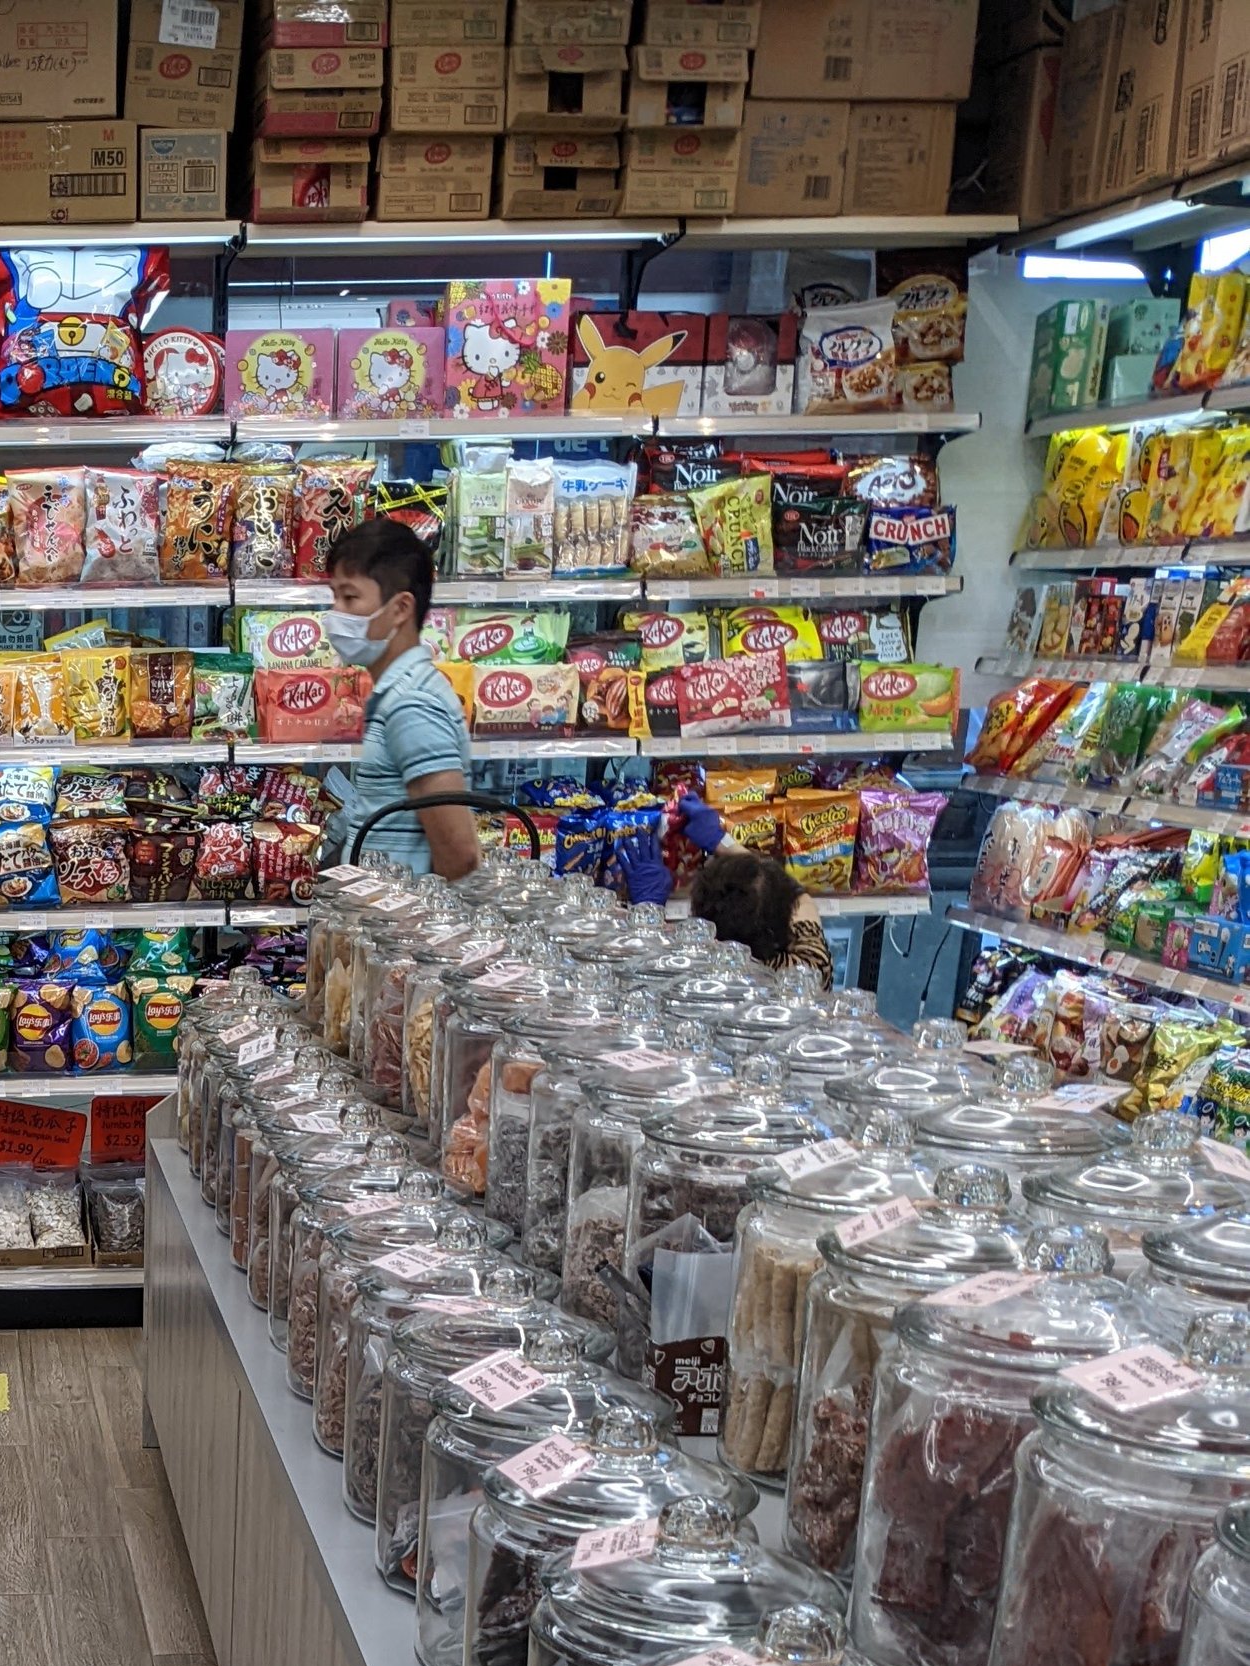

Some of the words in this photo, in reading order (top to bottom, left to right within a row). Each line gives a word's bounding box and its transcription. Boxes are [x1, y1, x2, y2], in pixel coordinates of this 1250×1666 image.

[93, 151, 124, 167] M50
[676, 462, 721, 484] Noir
[561, 478, 628, 494] 牛乳ケーキ
[114, 486, 138, 553] ふわっと
[872, 518, 950, 543] CRUNCH
[799, 524, 843, 546] Noir
[273, 624, 317, 652] KitKat
[464, 627, 507, 655] KitKat
[748, 623, 794, 649] KitKat
[267, 659, 293, 669] BANANA
[294, 658, 323, 669] CARAMEL
[282, 681, 324, 708] KitKat
[484, 678, 527, 700] KitKat
[688, 671, 729, 699] KitKat
[864, 674, 914, 697] KitKat
[732, 816, 776, 844] Cheetos
[801, 806, 848, 836] Cheetos
[0, 1127, 22, 1138] Salted
[22, 1130, 53, 1143] Pumpkin
[53, 1134, 70, 1145] Seed
[102, 1119, 132, 1130] Jumbo
[675, 1357, 700, 1366] meiji
